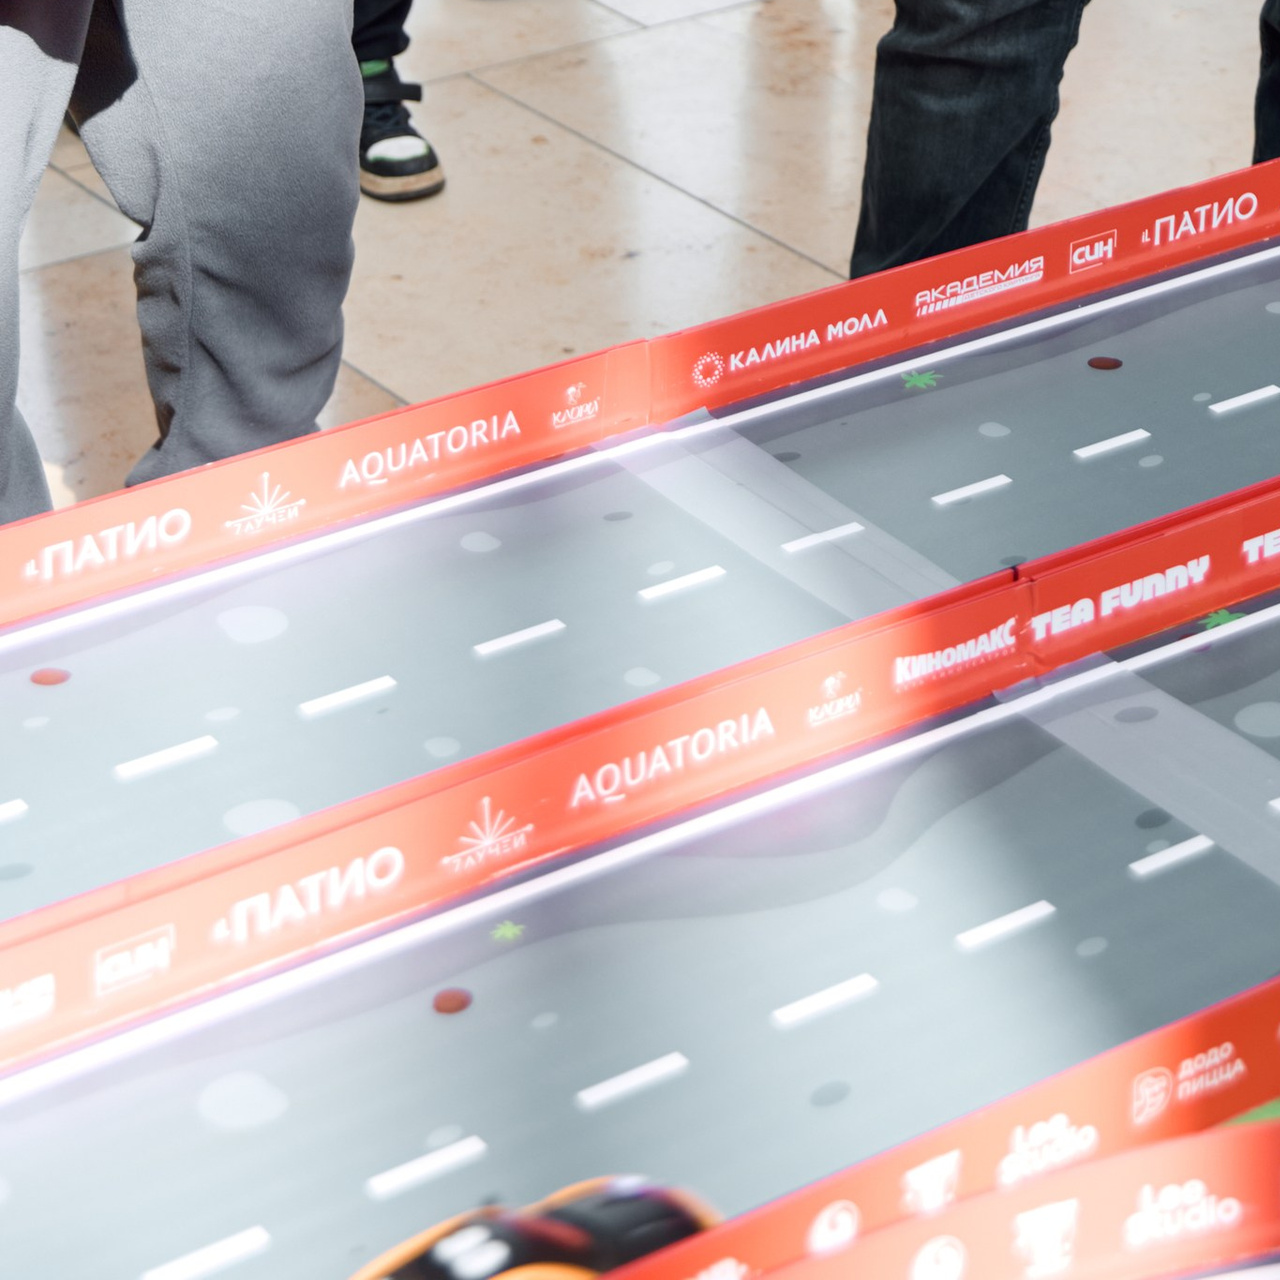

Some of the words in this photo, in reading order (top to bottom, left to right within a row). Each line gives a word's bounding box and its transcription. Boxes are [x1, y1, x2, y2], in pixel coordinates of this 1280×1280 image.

[1154, 192, 1258, 245] ПАТИО
[915, 256, 1044, 307] АКАДЕМИЯ
[730, 329, 820, 371] КАЛИНА
[827, 309, 888, 341] МОЛЛ
[340, 410, 521, 488] AQUATORIA
[43, 508, 191, 580] ПАТИО
[1031, 597, 1095, 642] TEA
[1100, 555, 1210, 616] FUNNY
[895, 617, 1016, 683] КИНОМАКС
[571, 707, 774, 808] AQUATORIA
[230, 846, 403, 940] ПАТИО
[1178, 1042, 1234, 1078] ДОДО
[1178, 1058, 1246, 1099] ПИЦЦА
